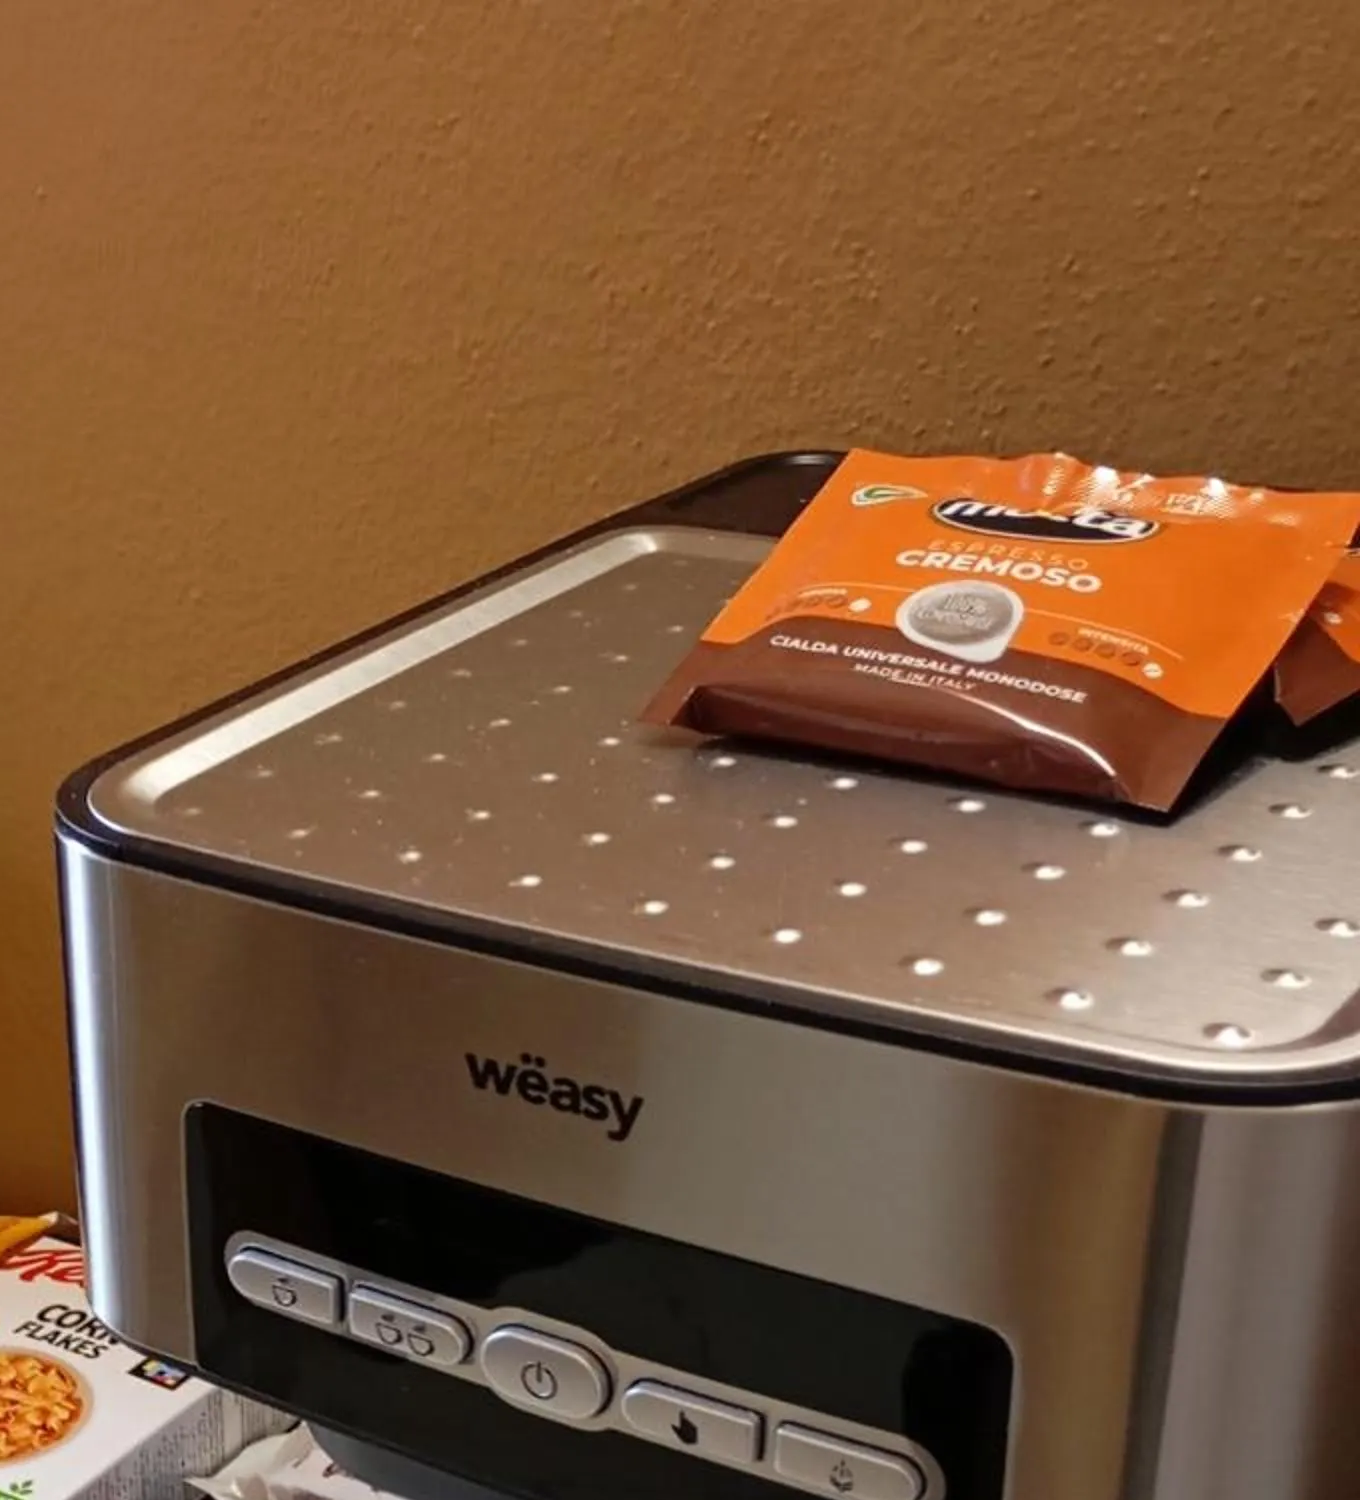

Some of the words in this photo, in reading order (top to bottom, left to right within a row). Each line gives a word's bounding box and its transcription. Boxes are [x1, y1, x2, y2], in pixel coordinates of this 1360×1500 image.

[895, 549, 1103, 594] CREMOSO
[927, 539, 1090, 571] ESPRESSO
[770, 634, 839, 658] CIALDA
[842, 645, 965, 676] UNIVERSALE
[967, 665, 1088, 704] MONODOSE
[853, 662, 903, 681] MADE
[906, 671, 926, 683] IN
[928, 674, 977, 691] ITALY
[465, 1052, 644, 1142] wëasy
[12, 1320, 109, 1359] FLAKES
